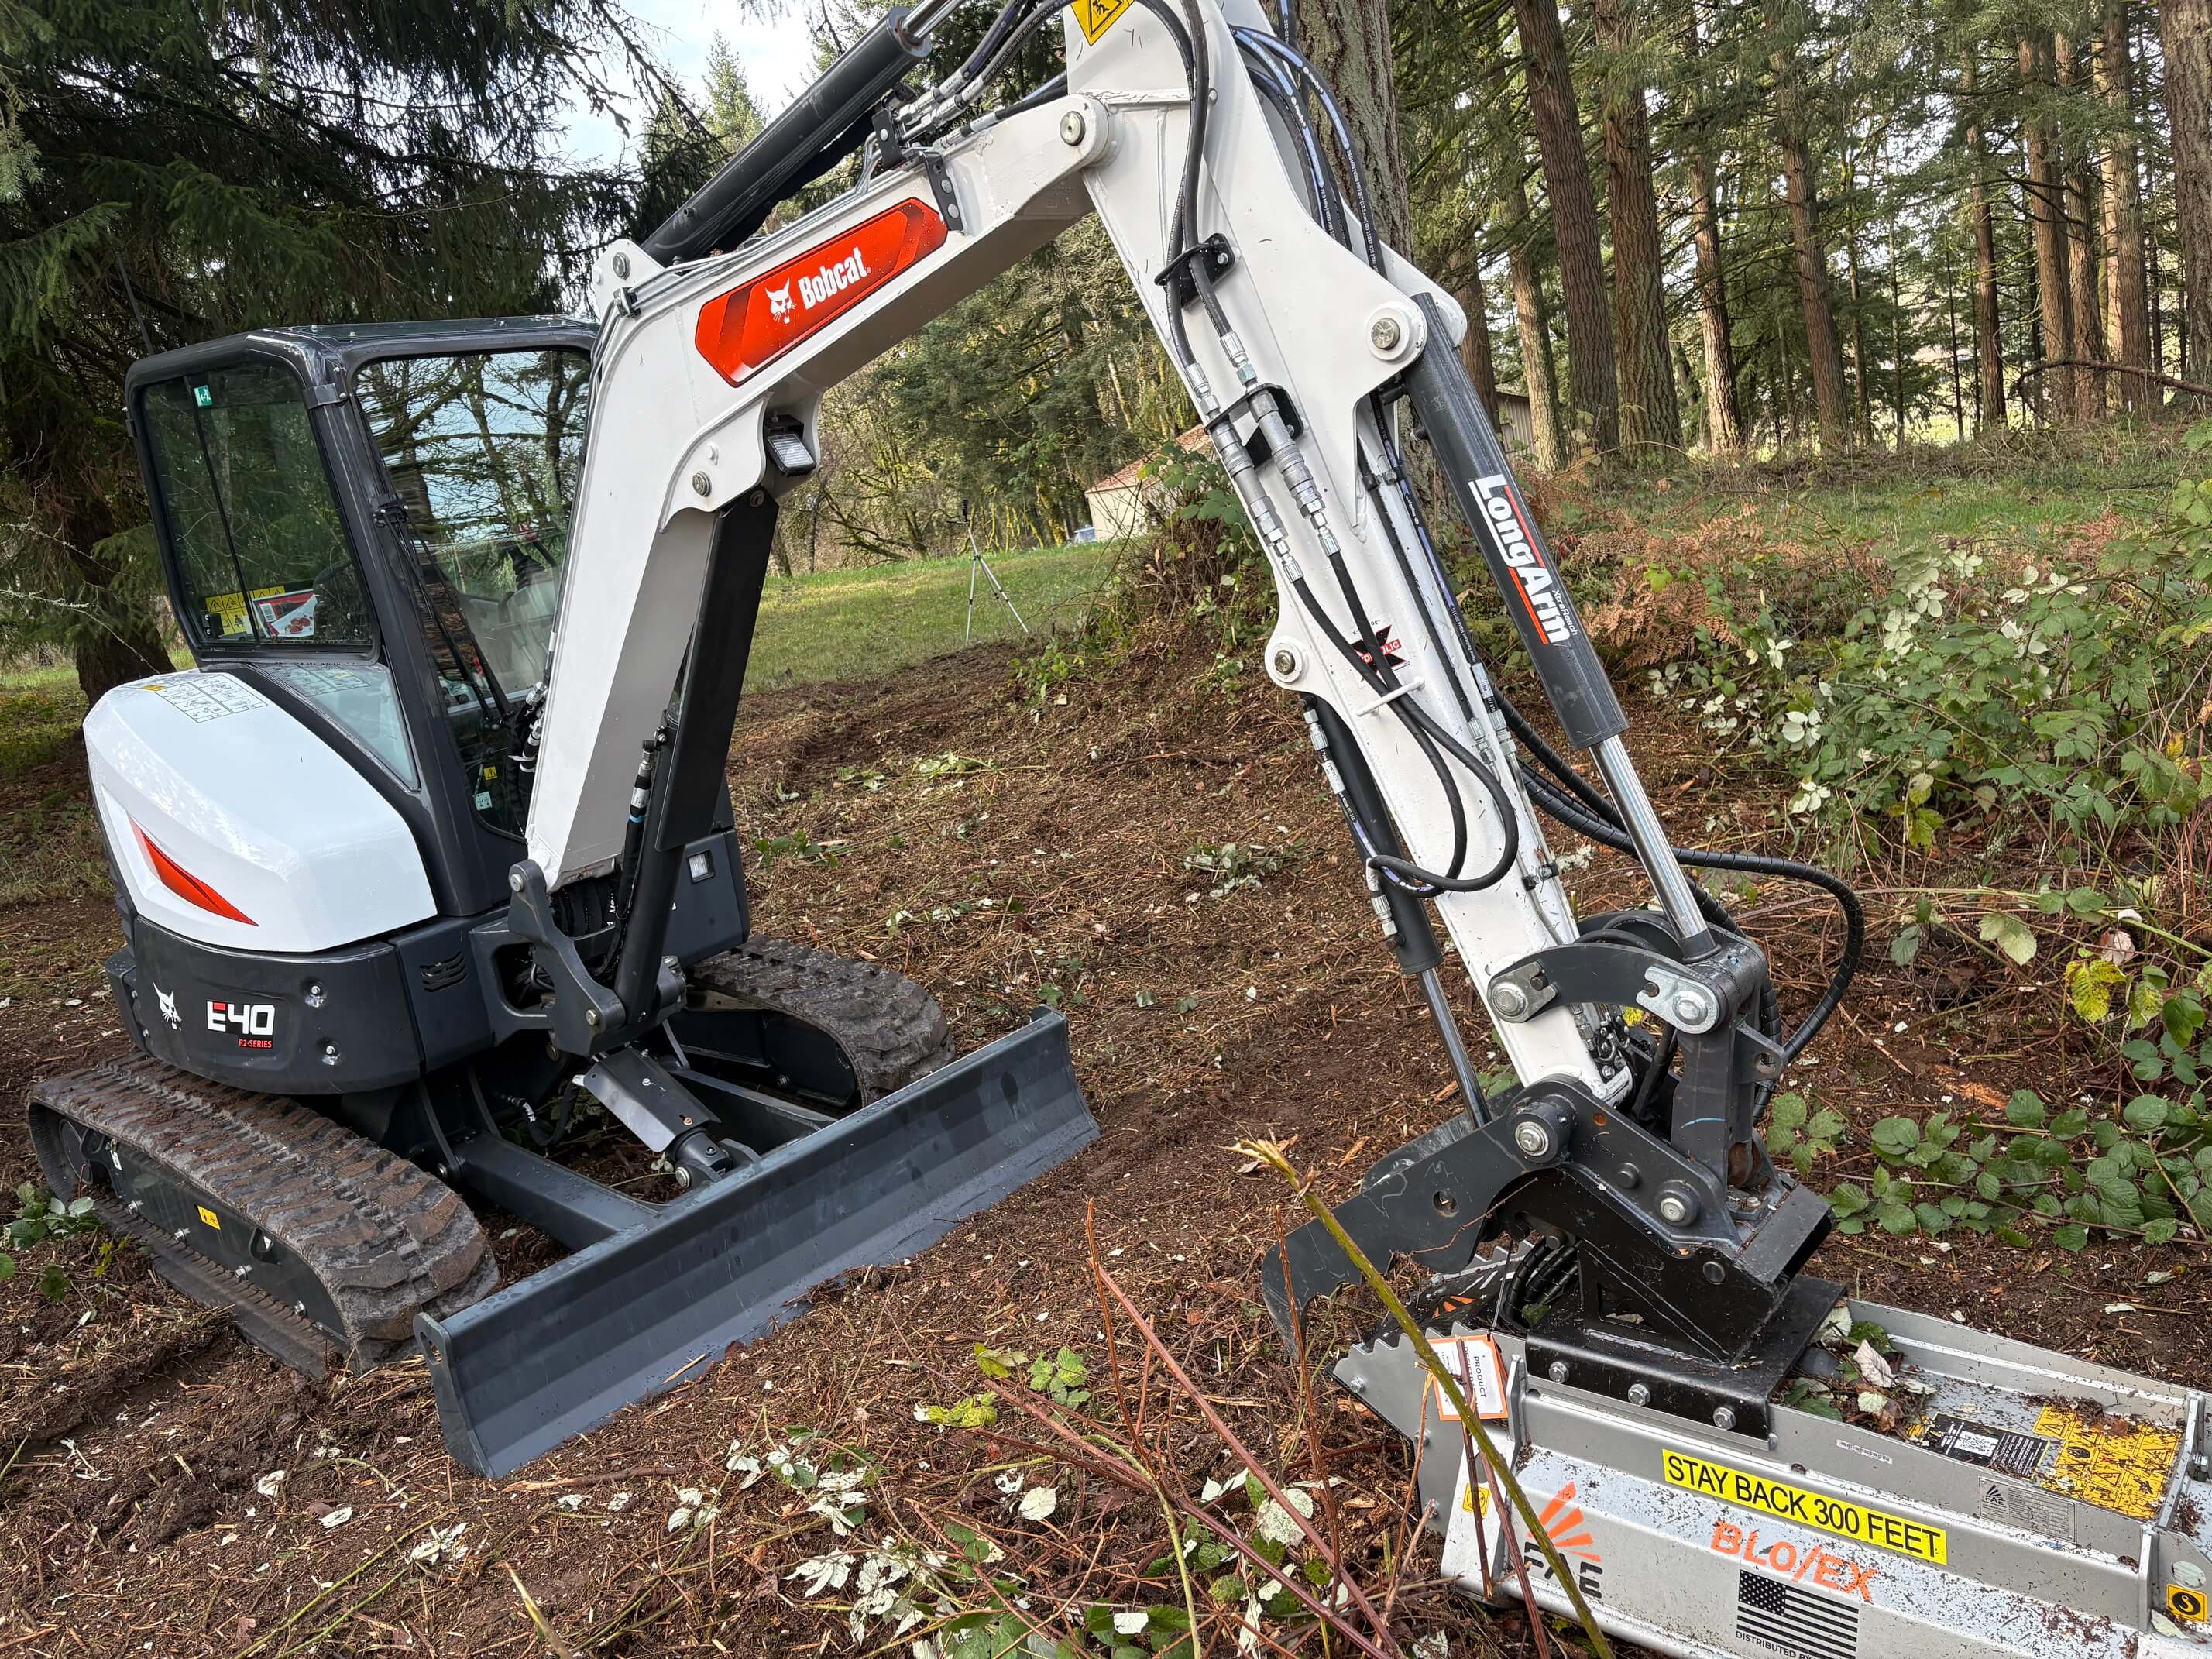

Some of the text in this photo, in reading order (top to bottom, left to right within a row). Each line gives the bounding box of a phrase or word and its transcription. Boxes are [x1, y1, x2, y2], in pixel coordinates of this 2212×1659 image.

[798, 246, 867, 310] Bobcat
[1470, 474, 1571, 644] LongArm
[207, 1001, 275, 1036] E40
[239, 1039, 273, 1049] R2-SERIES
[1473, 1355, 1486, 1398] PRODUCT
[1668, 1455, 1941, 1558] STAY BACK 300 FEET
[1736, 1630, 1796, 1659] DISTRIBUTED
